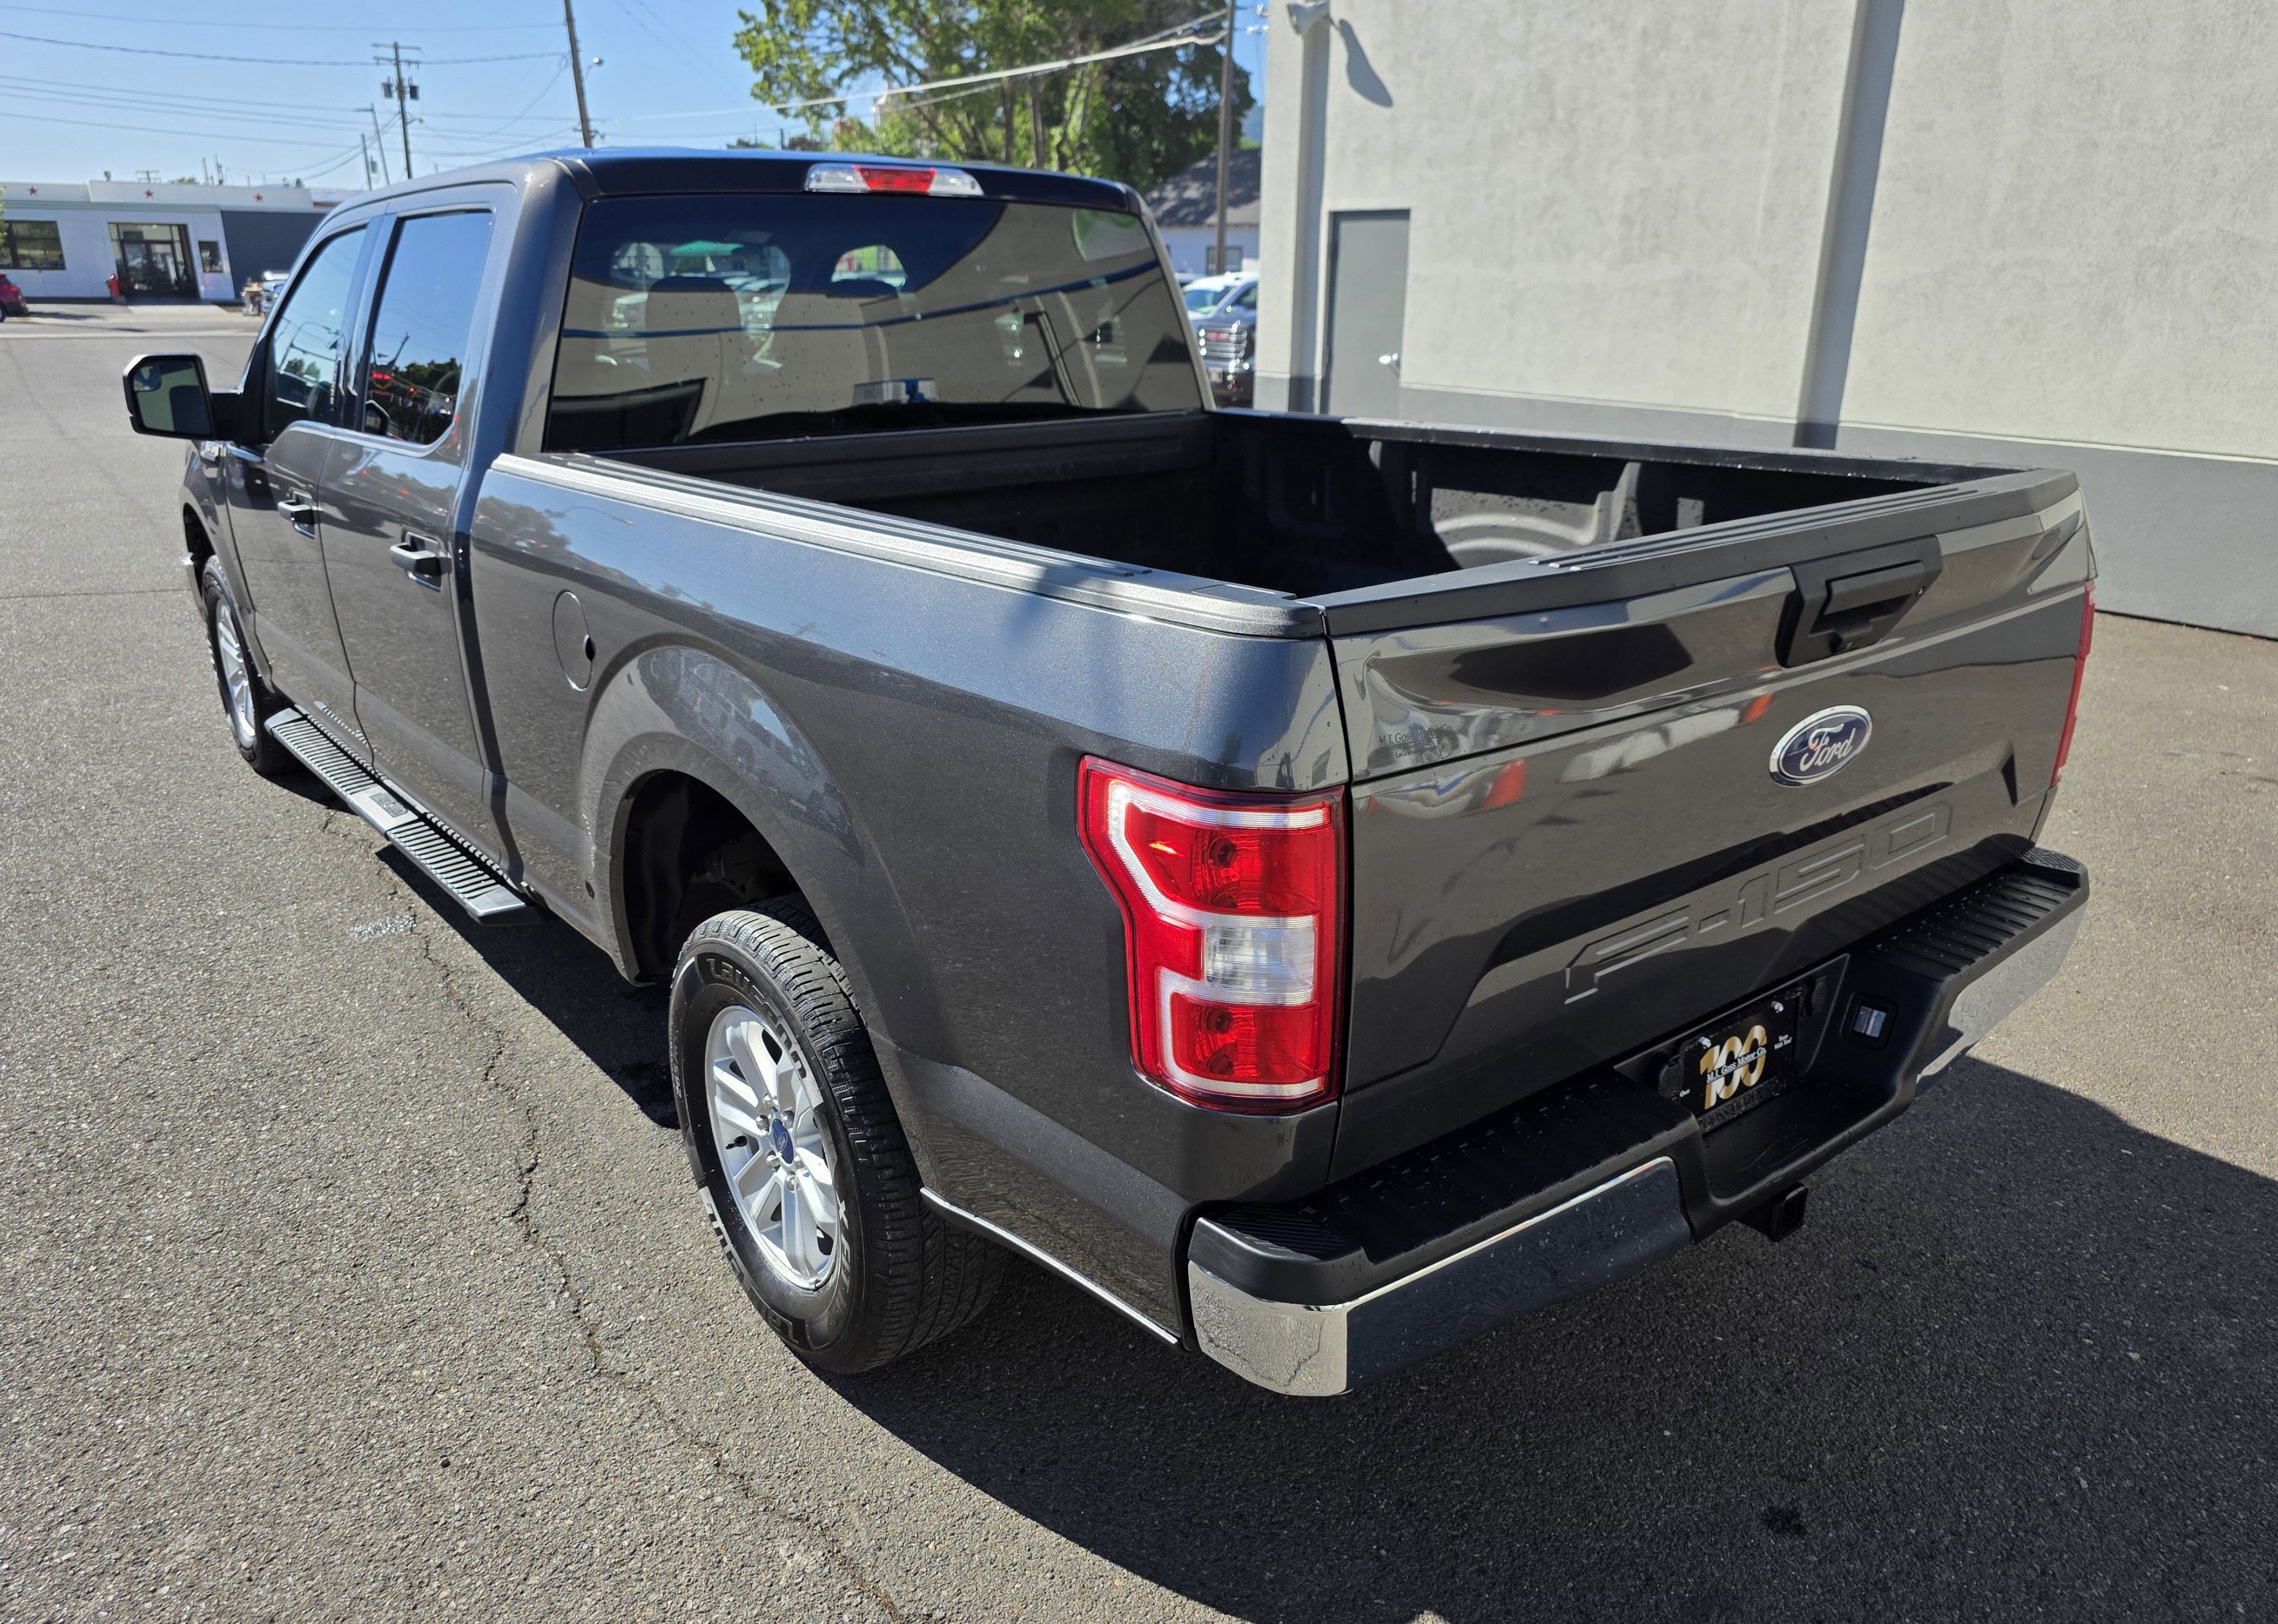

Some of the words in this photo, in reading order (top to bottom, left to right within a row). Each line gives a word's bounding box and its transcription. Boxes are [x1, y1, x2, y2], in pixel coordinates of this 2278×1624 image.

[1394, 732, 1414, 744] Gos
[1800, 723, 1856, 772] Ford
[1564, 801, 1953, 1004] F-150
[1700, 1024, 1767, 1110] 100
